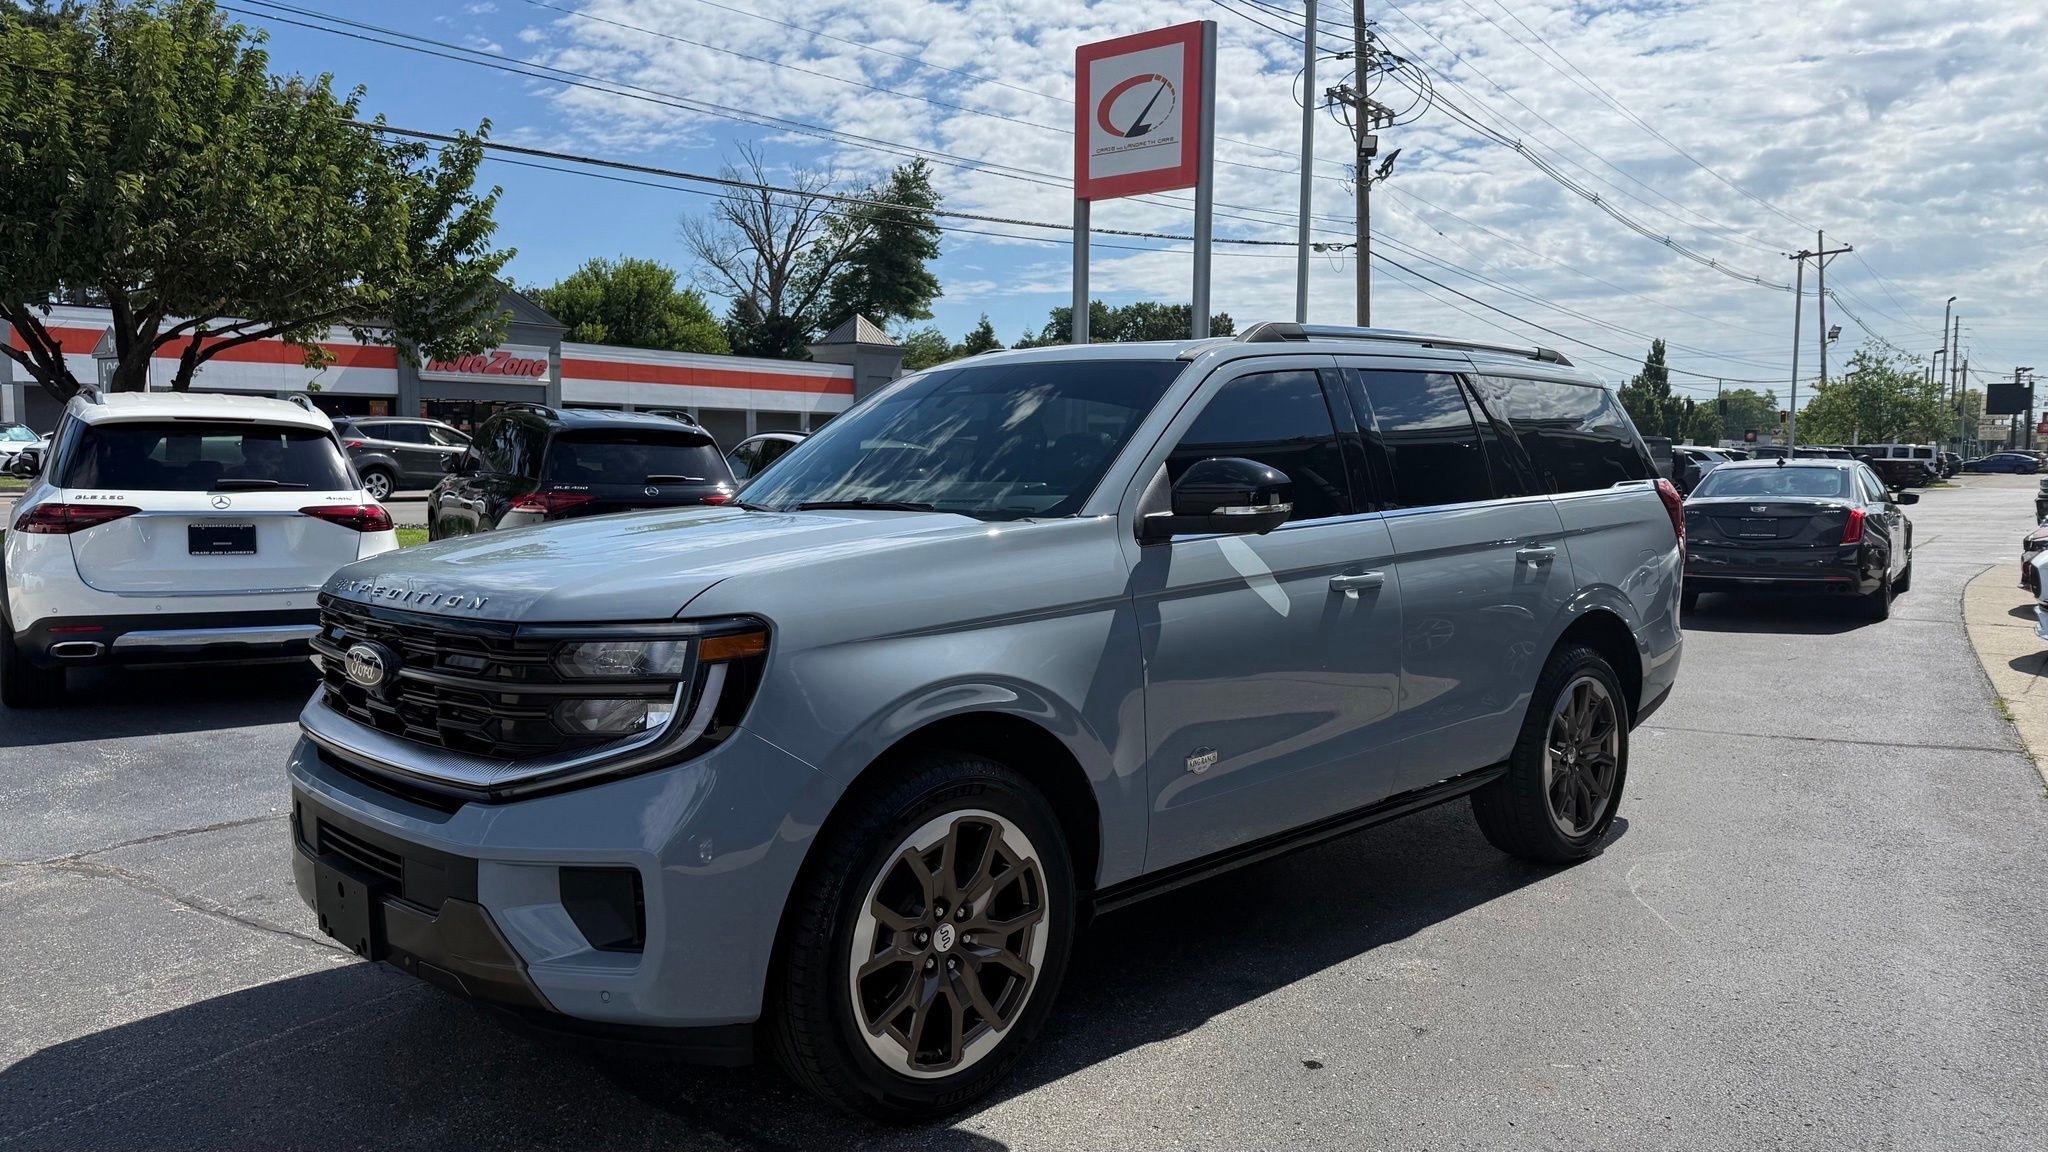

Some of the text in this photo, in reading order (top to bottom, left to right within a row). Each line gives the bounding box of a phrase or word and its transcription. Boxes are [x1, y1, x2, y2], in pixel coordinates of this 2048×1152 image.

[1157, 136, 1174, 144] CARS
[336, 578, 489, 610] EXPEDITION
[350, 651, 377, 680] Ford
